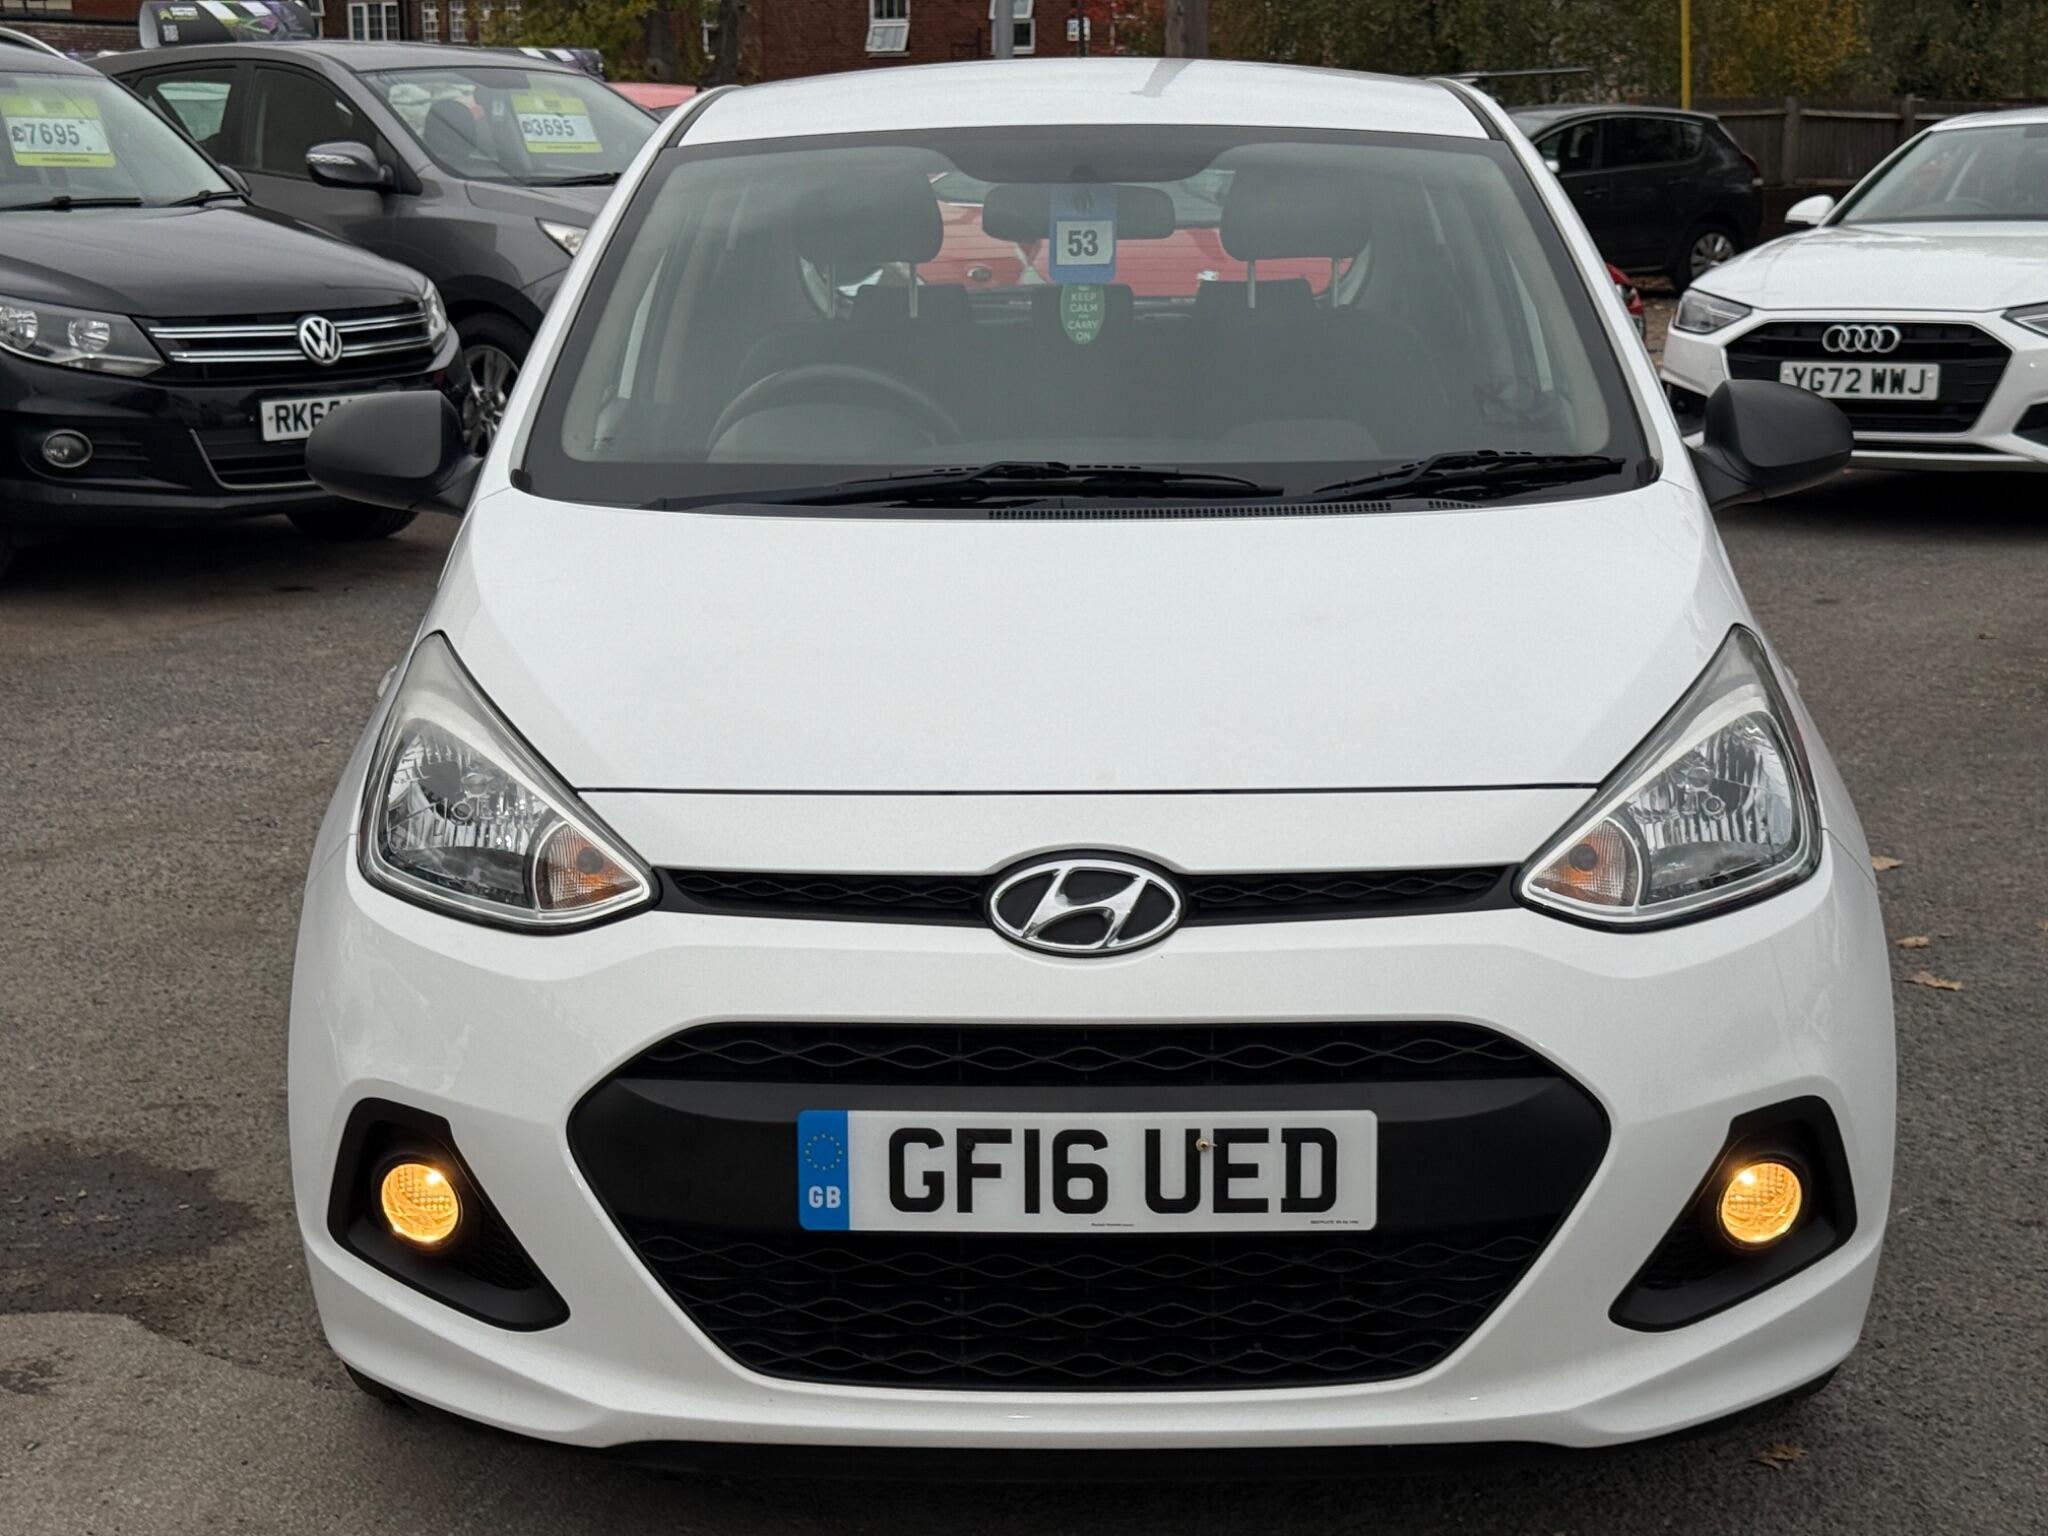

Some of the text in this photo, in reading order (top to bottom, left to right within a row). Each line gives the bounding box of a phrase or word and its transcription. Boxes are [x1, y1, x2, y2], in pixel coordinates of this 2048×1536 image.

[11, 123, 80, 146] £7695
[1067, 229, 1099, 257] 53
[1069, 303, 1098, 313] CALM
[1070, 292, 1097, 302] KEEP
[1067, 320, 1099, 331] CARRY
[1075, 332, 1092, 342] ON
[1792, 367, 1926, 395] YG72 WWJ
[889, 1127, 1338, 1214] GF16 UED
[808, 1185, 841, 1209] GB
